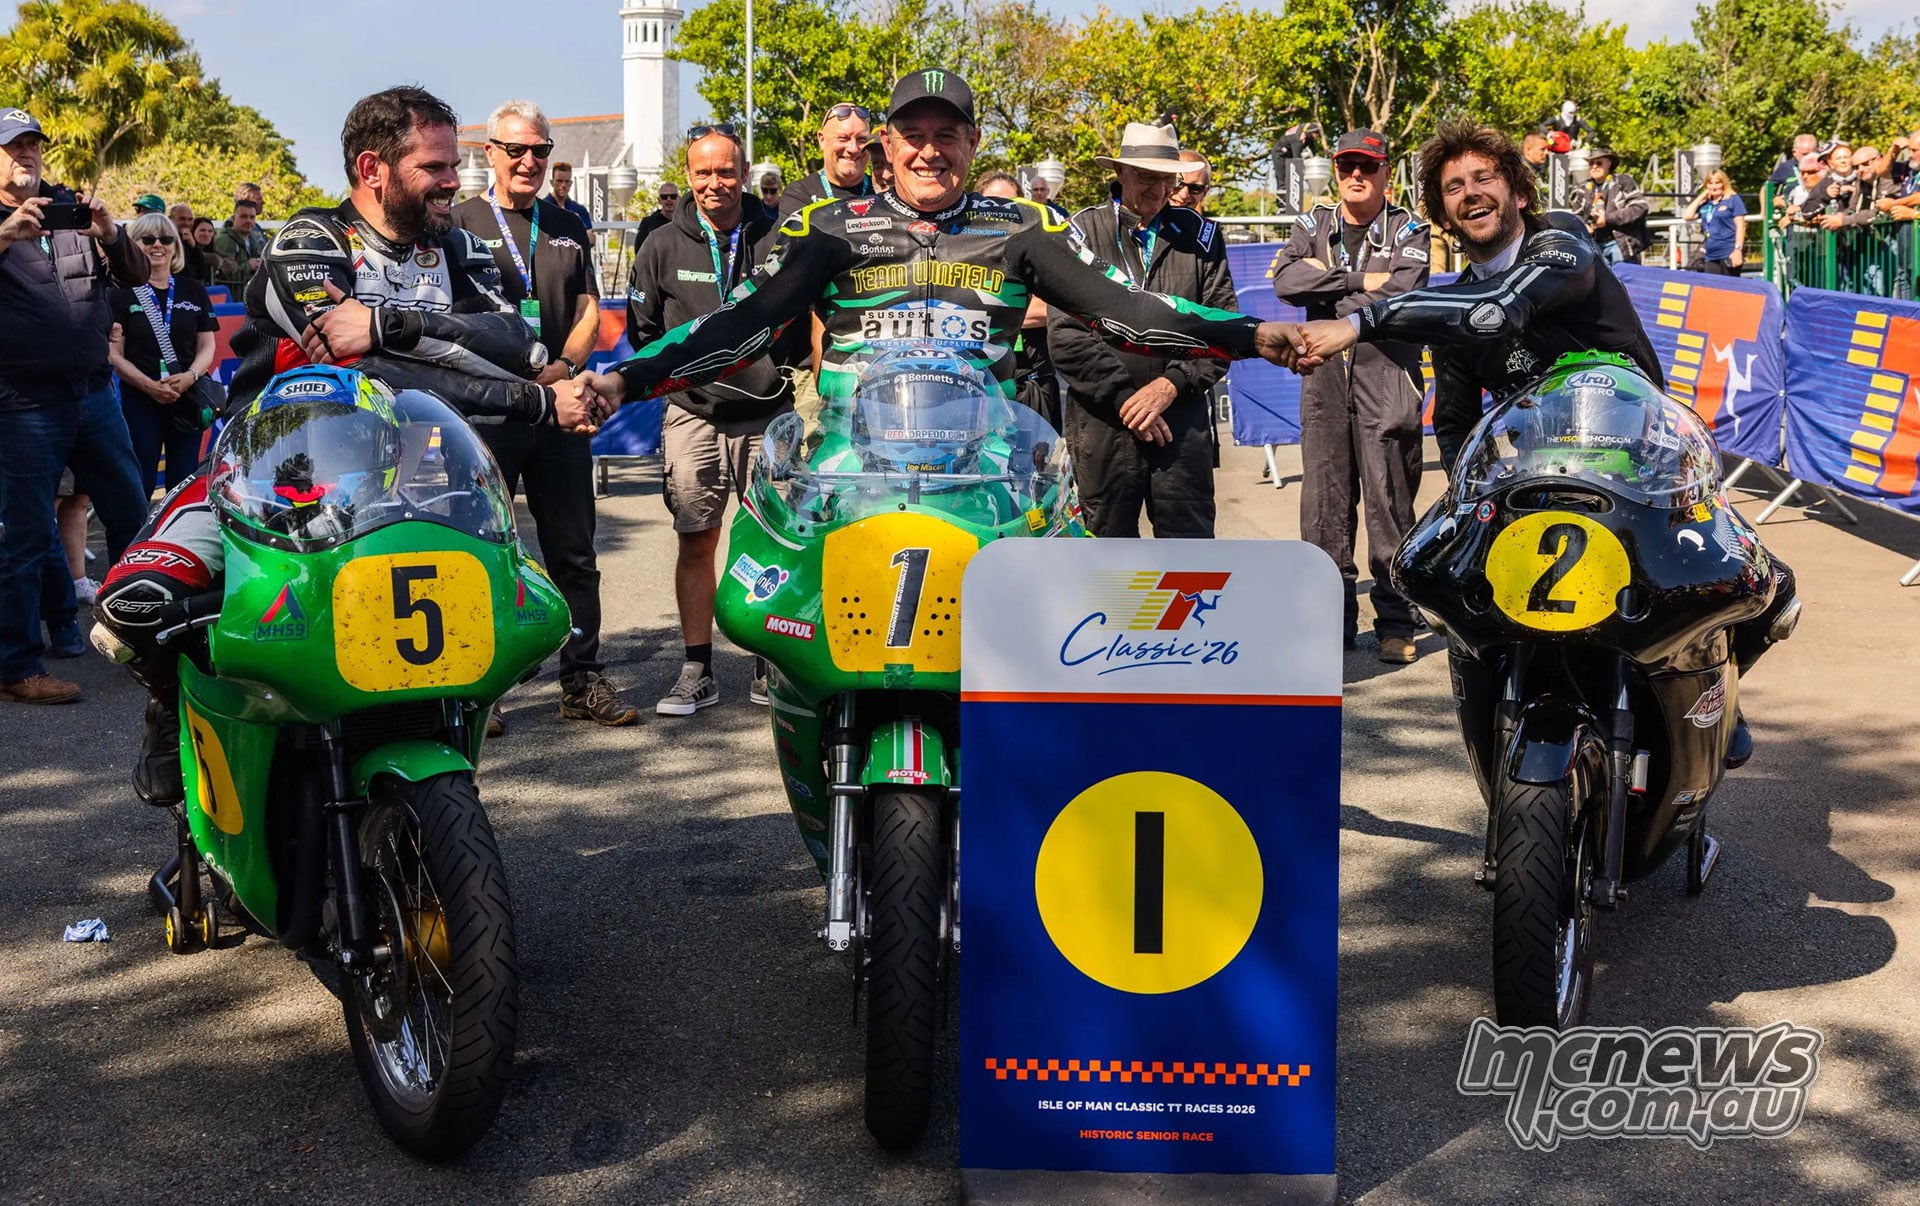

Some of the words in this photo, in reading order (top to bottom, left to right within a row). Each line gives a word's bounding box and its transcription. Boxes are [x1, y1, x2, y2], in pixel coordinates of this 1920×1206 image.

[1289, 163, 1301, 212] RST
[593, 177, 604, 223] RST
[850, 263, 907, 294] TEAM
[912, 260, 1005, 294] WINFIELD
[864, 313, 987, 340] autos
[908, 374, 953, 384] Bennetts
[1570, 372, 1609, 385] Arai
[285, 383, 326, 395] SHOEI
[921, 463, 945, 471] Macari
[1528, 524, 1588, 612] 2
[757, 575, 776, 594] inks
[108, 599, 164, 612] RST
[885, 548, 931, 648] 1
[391, 565, 443, 665] 5
[515, 609, 547, 620] MH59
[257, 624, 305, 640] MH59
[767, 617, 812, 638] MOTUL
[1060, 612, 1200, 666] Classic
[1201, 639, 1239, 665] '26
[888, 770, 929, 778] MOTUL
[1038, 1100, 1062, 1109] ISLE
[1066, 1101, 1083, 1110] OF
[1086, 1101, 1112, 1110] MAN
[1116, 1102, 1165, 1112] CLASSIC
[1167, 1104, 1182, 1112] TT
[1185, 1104, 1223, 1113] RACES
[1226, 1105, 1256, 1114] 2026
[1080, 1129, 1133, 1139] HISTORIC
[1136, 1131, 1179, 1140] SENIOR
[1182, 1132, 1213, 1141] RACE
